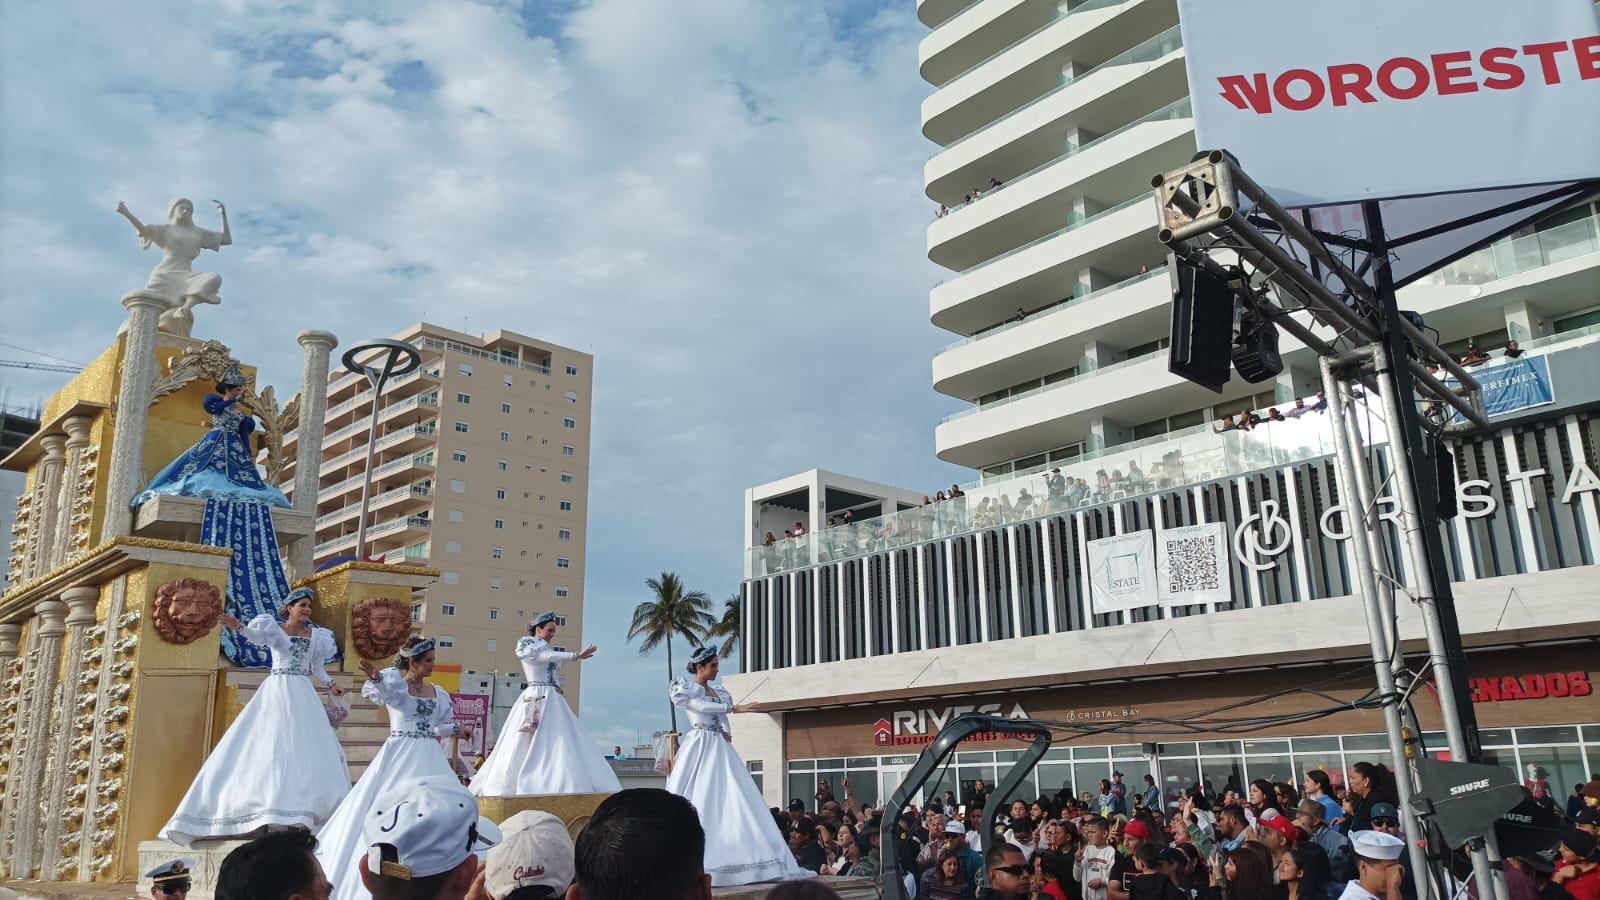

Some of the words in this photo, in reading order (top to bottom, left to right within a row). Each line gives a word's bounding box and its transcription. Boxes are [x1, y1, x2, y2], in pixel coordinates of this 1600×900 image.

[1216, 35, 1600, 114] NOROESTE
[1482, 372, 1538, 391] ERFIMEX
[1319, 463, 1600, 540] CRSTA
[1424, 671, 1592, 705] NADOS
[1078, 710, 1119, 720] CRISTAL
[1122, 708, 1141, 717] BAY
[1449, 778, 1491, 796] SHURE
